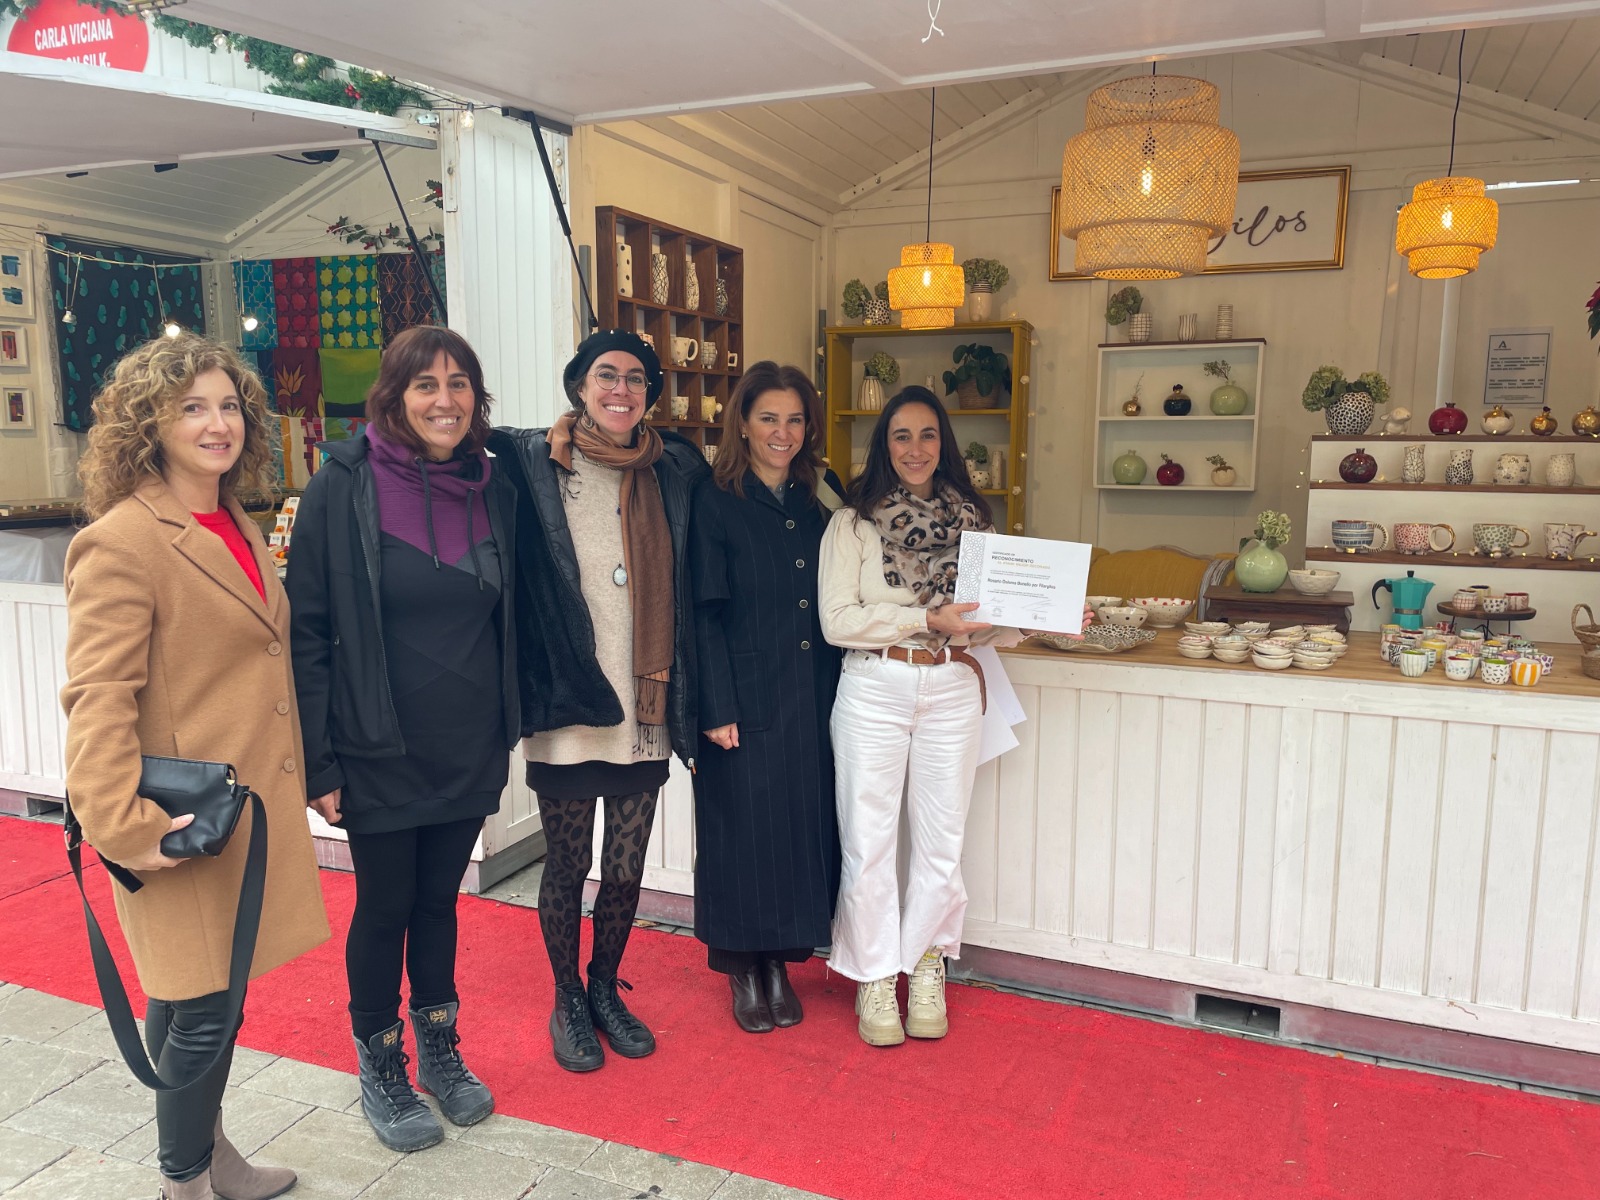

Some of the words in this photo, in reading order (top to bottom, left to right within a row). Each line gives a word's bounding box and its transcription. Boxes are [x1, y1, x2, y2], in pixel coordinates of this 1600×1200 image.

[34, 25, 68, 51] CARLA
[69, 18, 114, 45] VICIANA
[992, 555, 1034, 563] RECONOCIMIENTO
